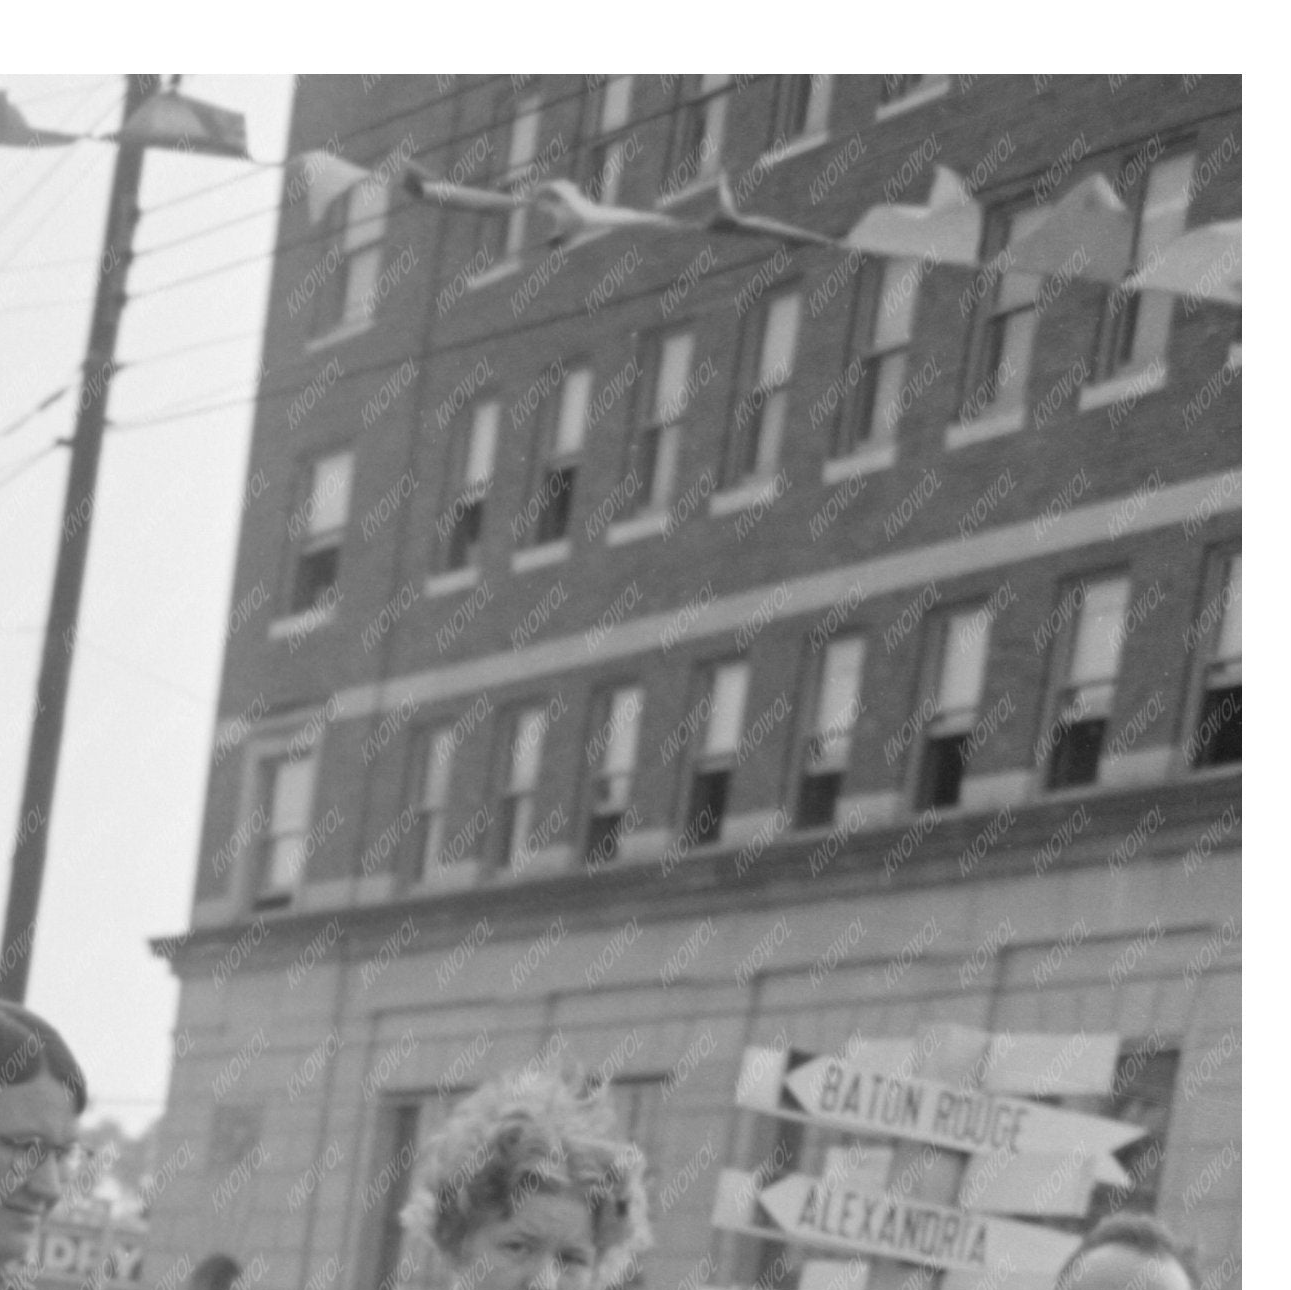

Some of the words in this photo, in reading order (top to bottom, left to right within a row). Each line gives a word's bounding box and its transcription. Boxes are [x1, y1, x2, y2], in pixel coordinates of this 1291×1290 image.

[819, 1062, 924, 1128] BATON
[932, 1089, 1030, 1156] ROUGE
[798, 1183, 987, 1267] ALEXANDRIA
